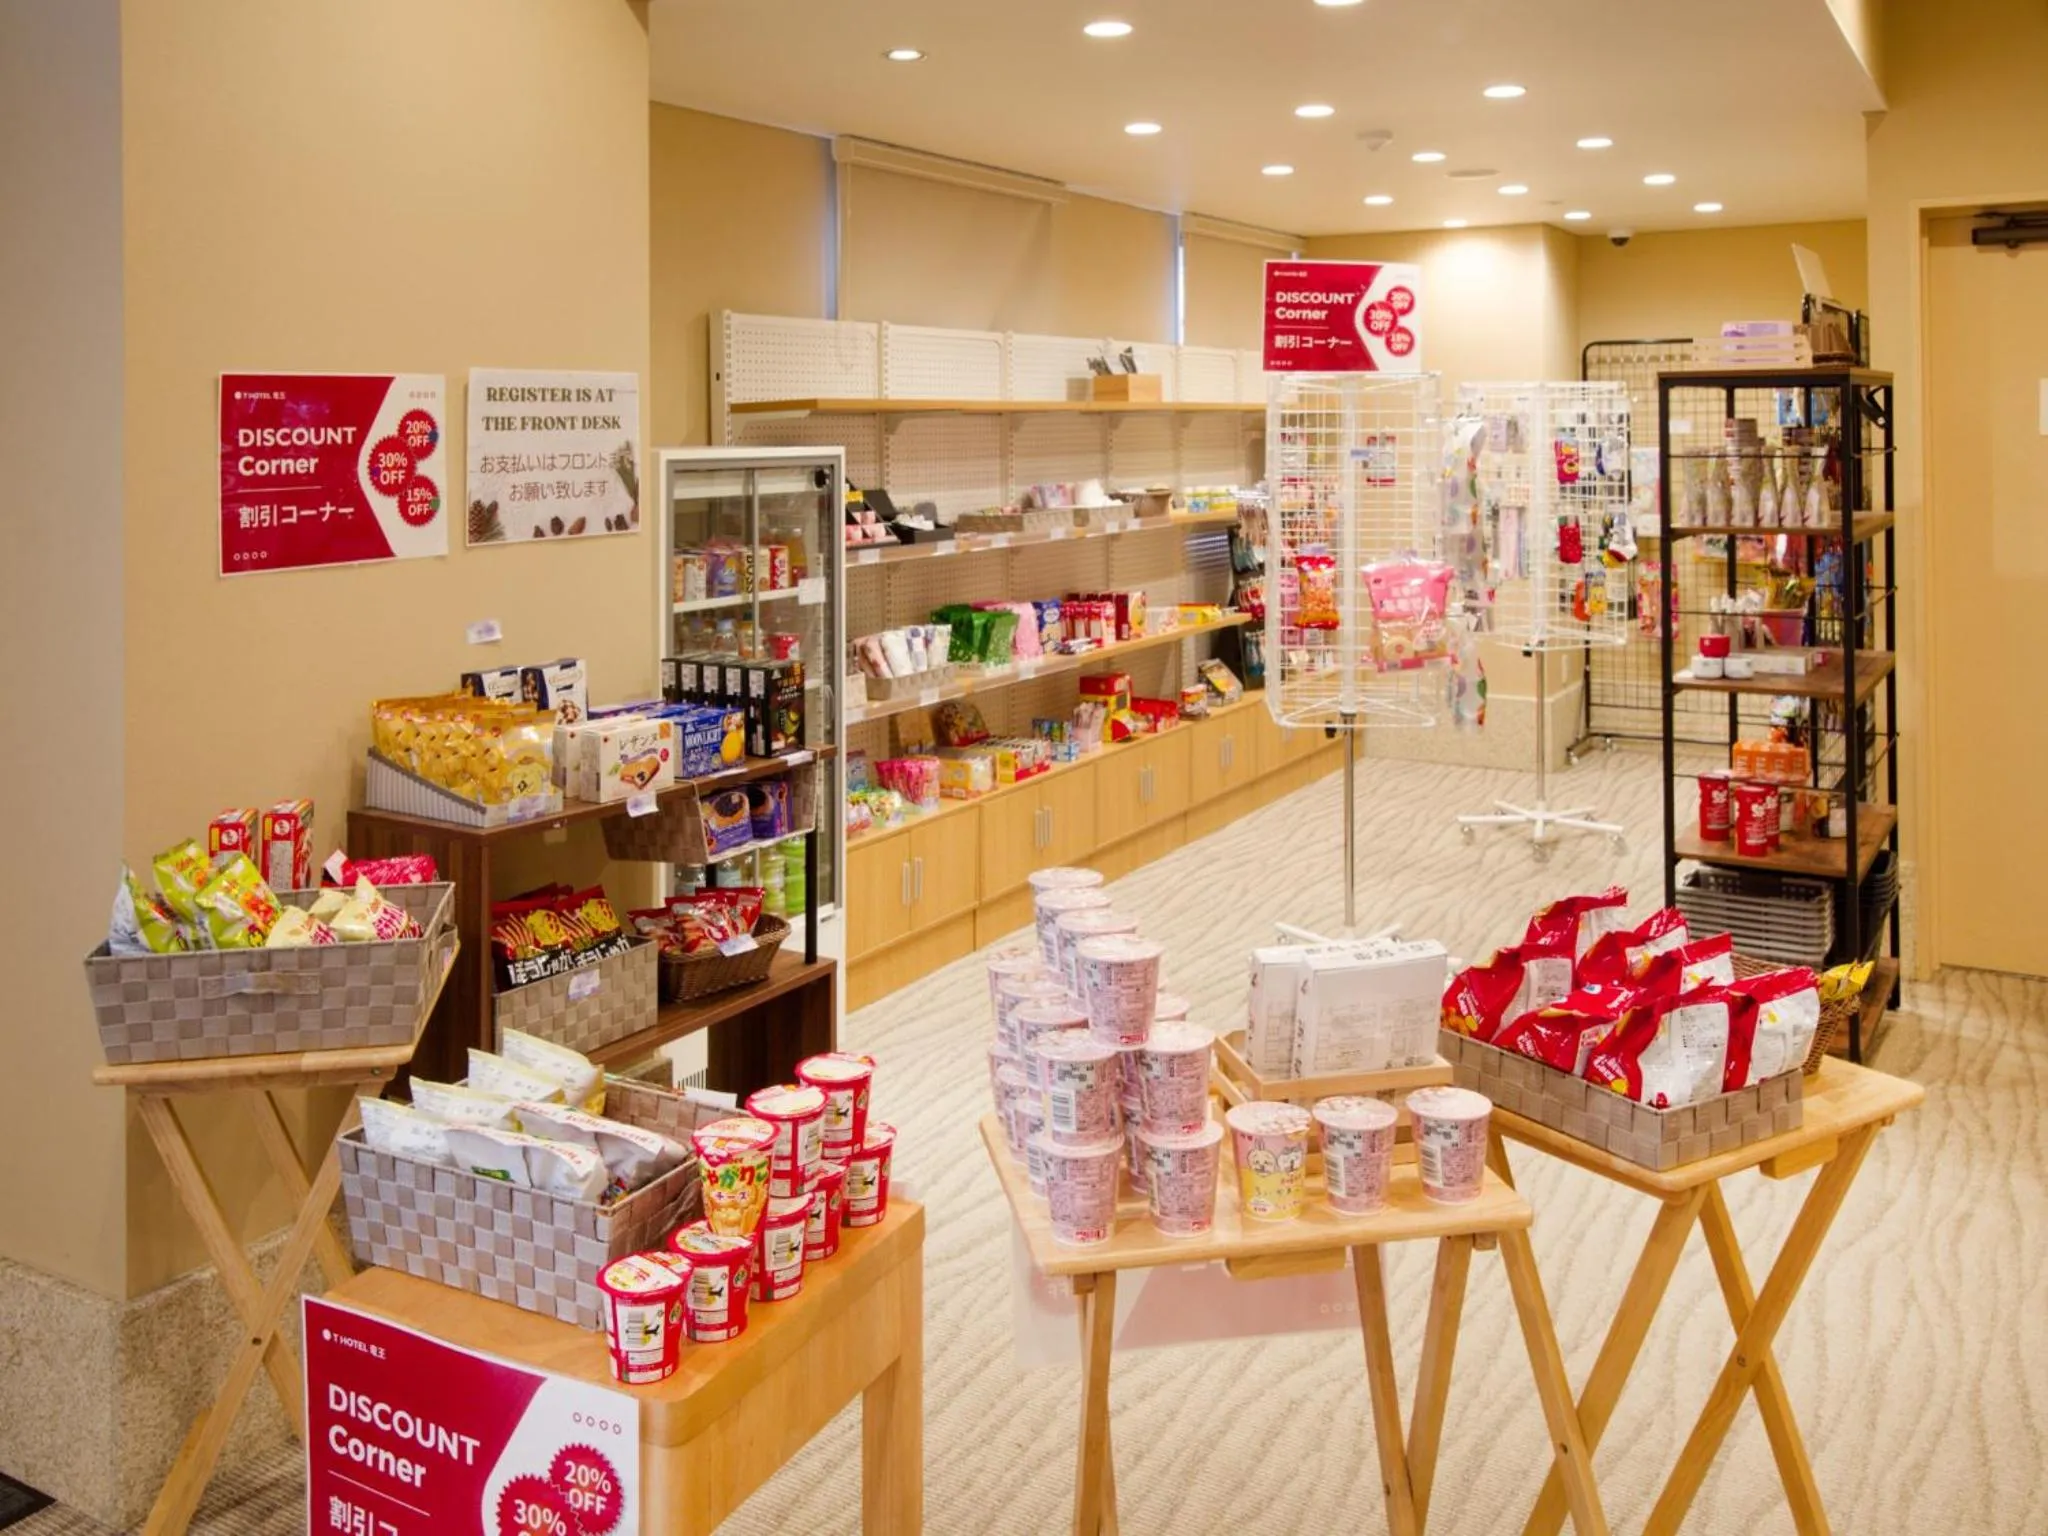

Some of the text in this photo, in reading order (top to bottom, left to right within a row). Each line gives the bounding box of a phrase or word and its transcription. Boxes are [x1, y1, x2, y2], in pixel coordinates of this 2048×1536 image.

[1275, 291, 1355, 305] DISCOUNT
[1275, 307, 1328, 320] Corner
[1274, 335, 1353, 349] 割引コーナー
[486, 386, 616, 403] REGISTER IS AT
[405, 420, 431, 435] 20%
[482, 415, 621, 431] THE FRONT DESK
[238, 427, 356, 448] DISCOUNT
[408, 434, 430, 448] OFF
[238, 455, 319, 477] Corner
[378, 452, 408, 468] 30%
[379, 469, 406, 485] OFF
[406, 488, 432, 503] 15%
[238, 502, 355, 529] 割引コーナー
[408, 503, 430, 517] OFF
[340, 1335, 368, 1353] HOTEL
[328, 1383, 480, 1466] DISCOUNT
[328, 1425, 427, 1488] Corner
[564, 1460, 612, 1494] 20%
[569, 1488, 606, 1515] OFF
[513, 1499, 567, 1536] 30%
